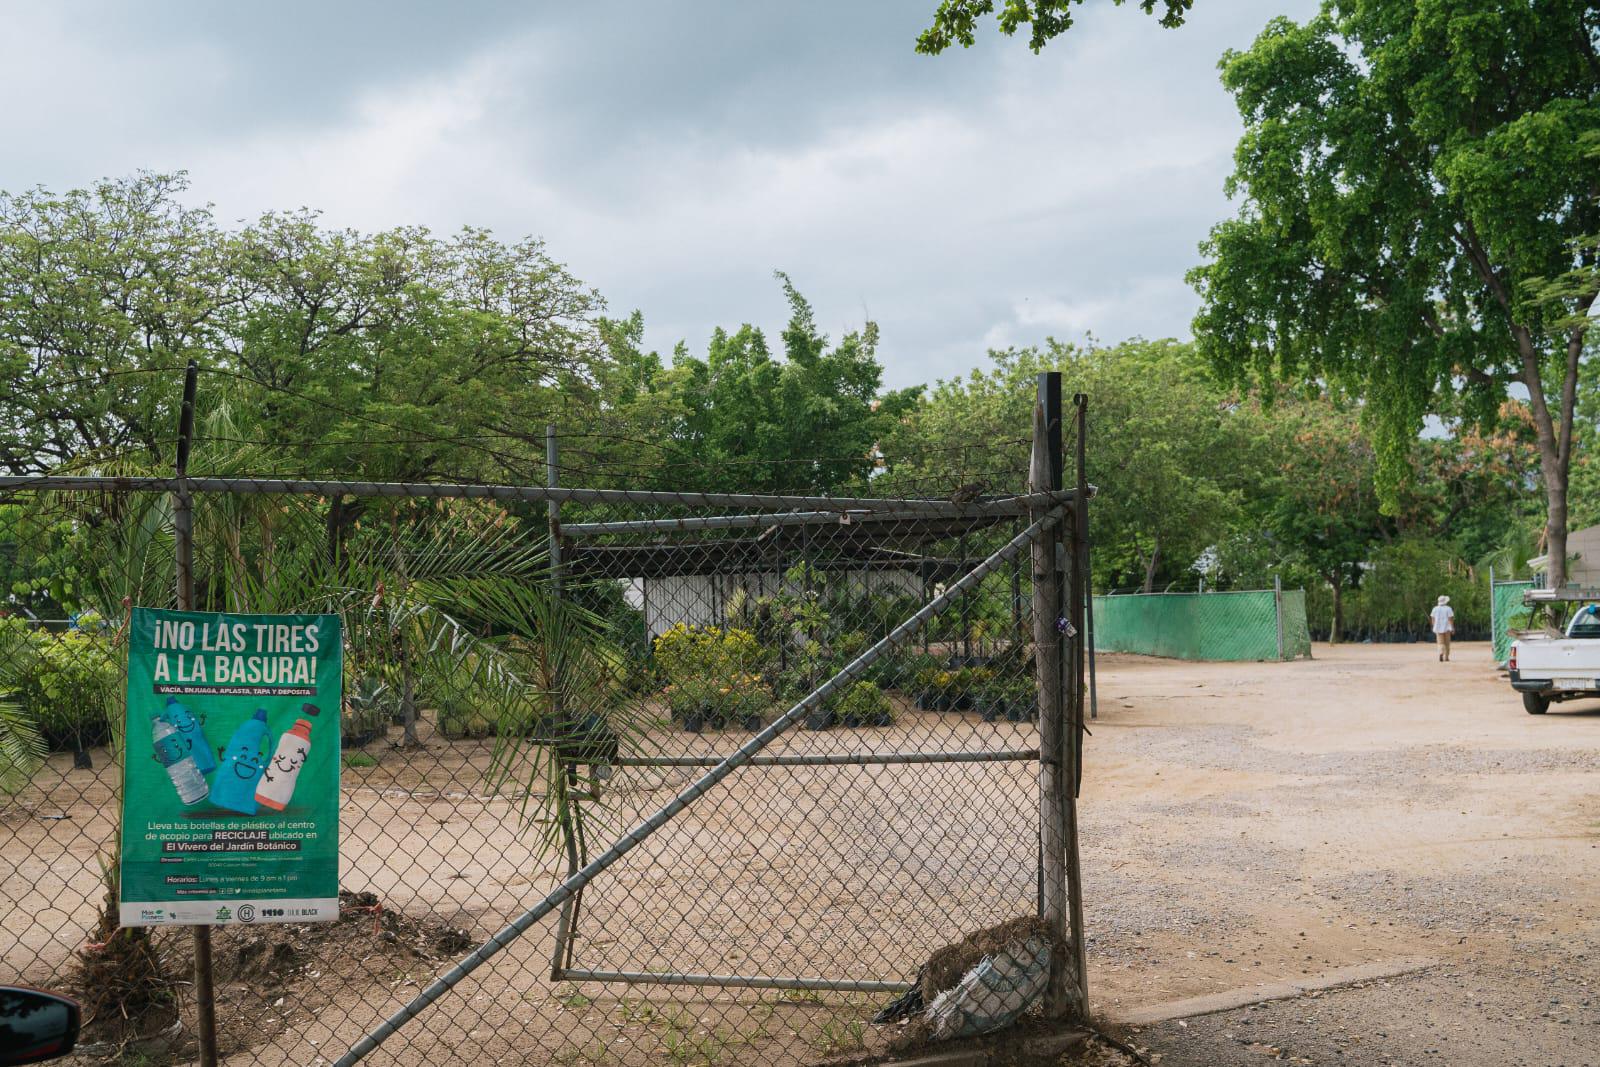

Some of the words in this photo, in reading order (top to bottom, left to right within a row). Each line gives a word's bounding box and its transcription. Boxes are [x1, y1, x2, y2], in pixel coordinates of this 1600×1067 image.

[154, 620, 194, 651] ¡NO
[202, 622, 246, 652] LAS
[253, 624, 319, 653] TIRES
[154, 653, 170, 681] A
[178, 654, 206, 682] LA
[215, 656, 317, 684] BASURA!
[148, 822, 172, 830] Lleva
[190, 822, 225, 830] botellas
[228, 822, 240, 830] de
[242, 822, 275, 831] plástico
[145, 832, 158, 840] de
[160, 833, 190, 841] acopio
[192, 833, 213, 841] para
[215, 831, 267, 840] RECICLAJE
[269, 831, 304, 839] ubicado
[166, 843, 175, 851] El
[177, 843, 208, 851] Vivero
[210, 843, 224, 851] del
[226, 842, 254, 850] Jardín
[257, 842, 297, 850] Botánico
